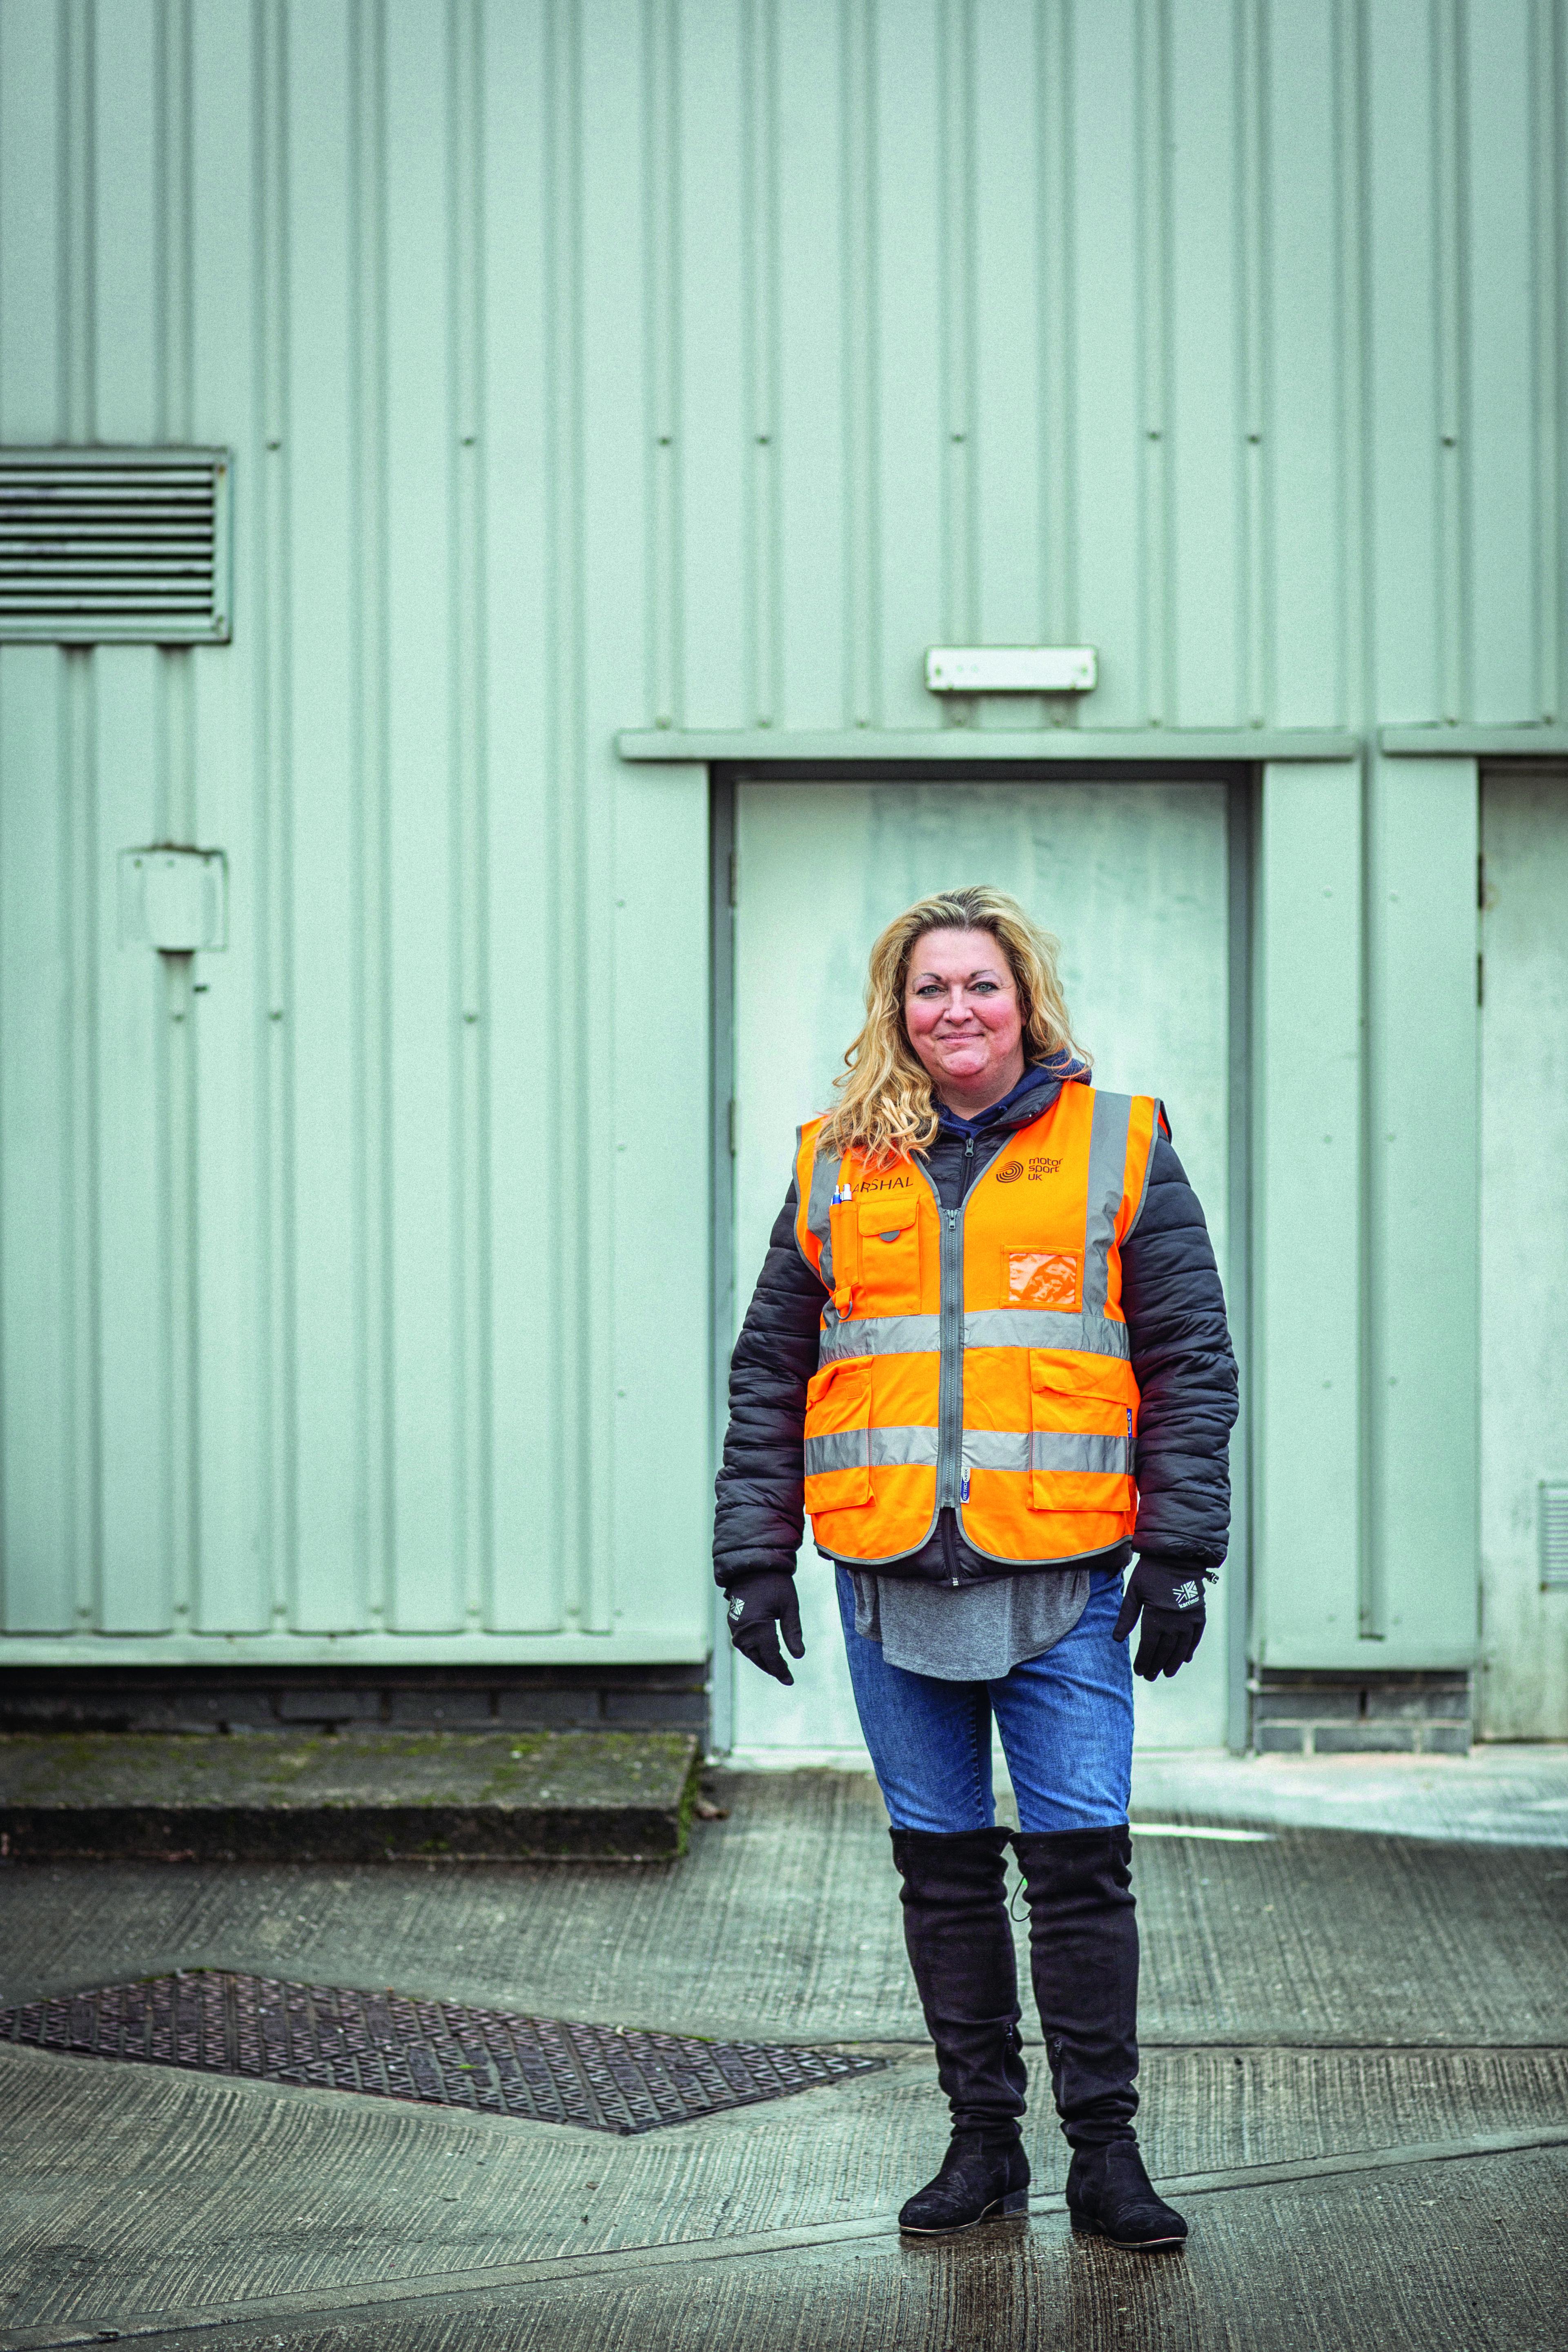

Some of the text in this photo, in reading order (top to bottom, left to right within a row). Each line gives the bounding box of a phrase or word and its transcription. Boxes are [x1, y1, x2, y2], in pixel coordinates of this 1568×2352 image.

[1029, 1157, 1064, 1166] motor
[1028, 1165, 1060, 1174] sport
[852, 1176, 914, 1194] ARSHAL
